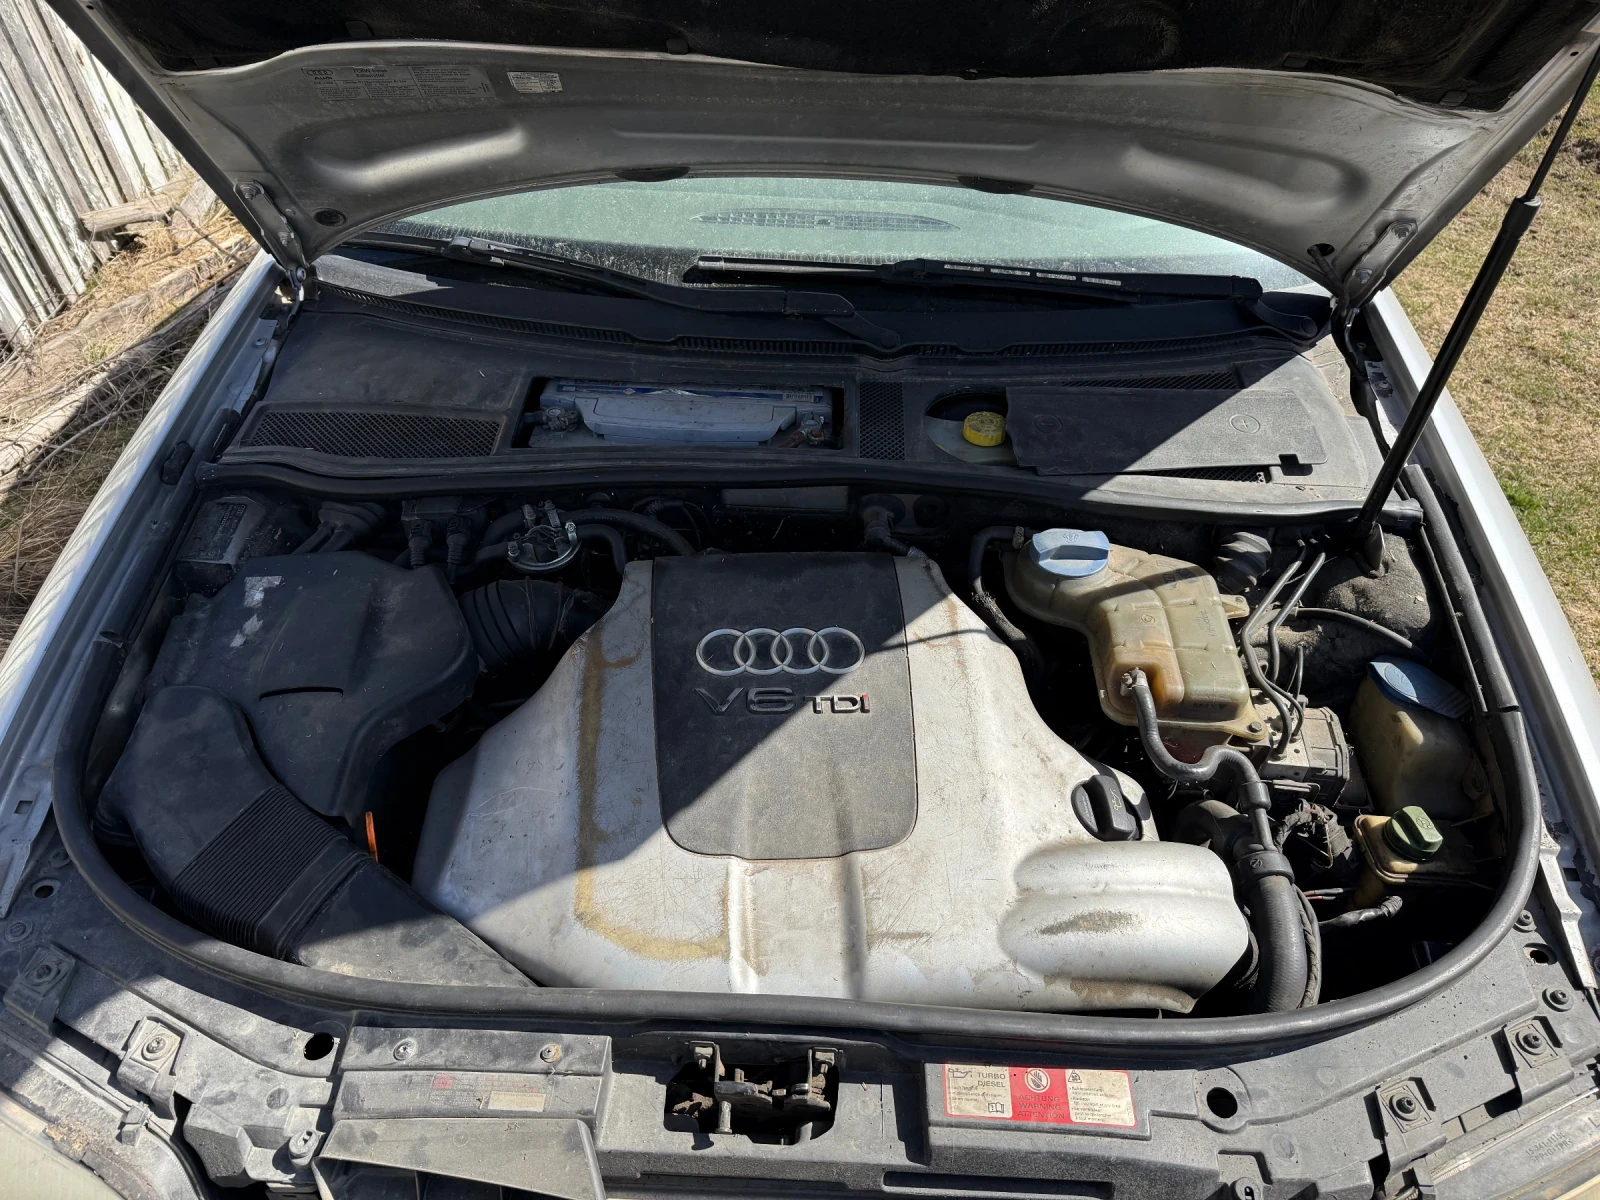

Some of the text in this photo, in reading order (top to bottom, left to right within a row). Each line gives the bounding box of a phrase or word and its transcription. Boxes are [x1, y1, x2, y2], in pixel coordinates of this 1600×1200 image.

[693, 687, 799, 715] V6
[977, 1072, 1006, 1080] TURBO
[1018, 1094, 1061, 1103] ACHTUNG
[1018, 1102, 1062, 1111] WARNING
[1017, 1110, 1065, 1119] ATTENTION
